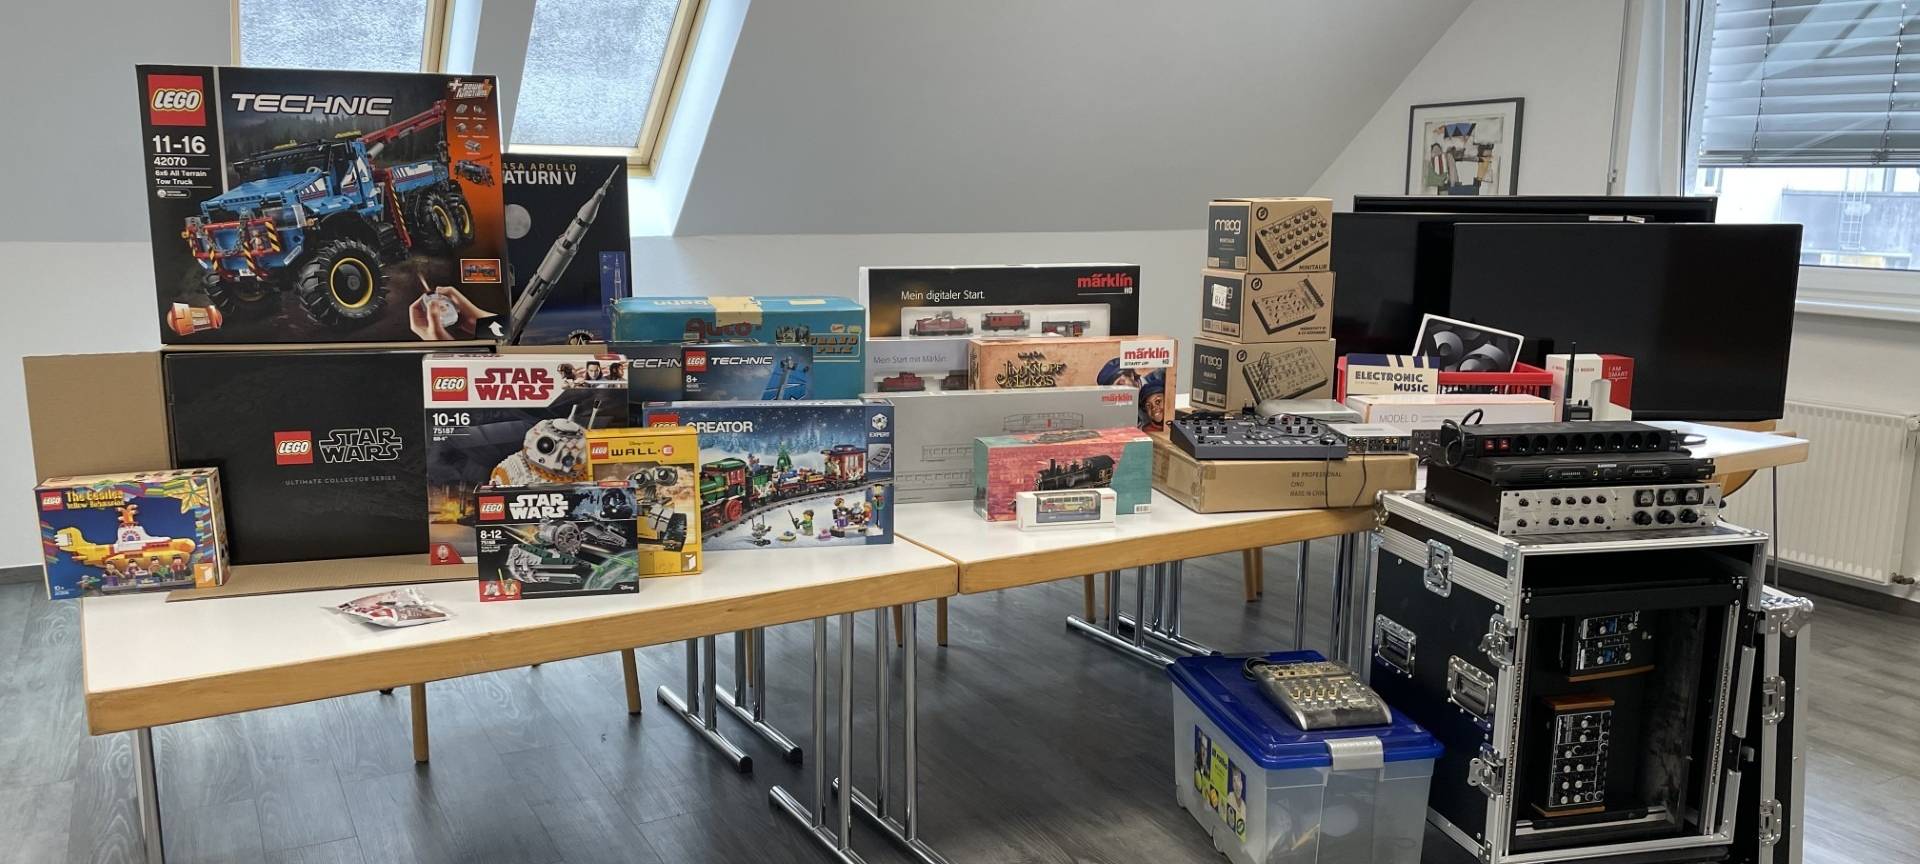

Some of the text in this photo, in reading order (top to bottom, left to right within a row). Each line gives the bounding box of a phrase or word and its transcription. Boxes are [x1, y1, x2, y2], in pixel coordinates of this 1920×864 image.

[152, 89, 202, 111] LEGO
[231, 93, 392, 115] TECHNIC
[153, 135, 206, 153] 11-16
[154, 157, 188, 166] 42070
[503, 162, 577, 171] ASA APOLLO
[503, 170, 577, 185] ATURN V
[1215, 219, 1241, 235] moog
[1077, 273, 1133, 288] märklin
[901, 289, 985, 302] Mein digitaler Start.
[873, 356, 891, 364] Mein
[892, 355, 907, 363] Start
[1124, 348, 1169, 360] märklin
[628, 358, 682, 368] ECHN
[686, 356, 772, 366] LEGO TECHNIC
[1200, 354, 1222, 370] moog
[475, 368, 554, 384] STAR
[686, 375, 698, 383] 8+
[1355, 371, 1423, 382] ELECTRONIC
[433, 377, 466, 391] LEGO
[1394, 383, 1428, 392] MUSIC
[475, 385, 554, 400] WARS
[432, 413, 470, 426] 10-16
[1377, 414, 1408, 423] MODEL
[319, 427, 402, 446] STAR
[277, 440, 311, 455] LEGO
[320, 444, 402, 463] WARS
[285, 478, 321, 486] ULTIMATE
[509, 494, 568, 507] STAR
[481, 503, 504, 512] LEGO
[510, 506, 568, 519] WARS
[480, 530, 502, 539] 8-12
